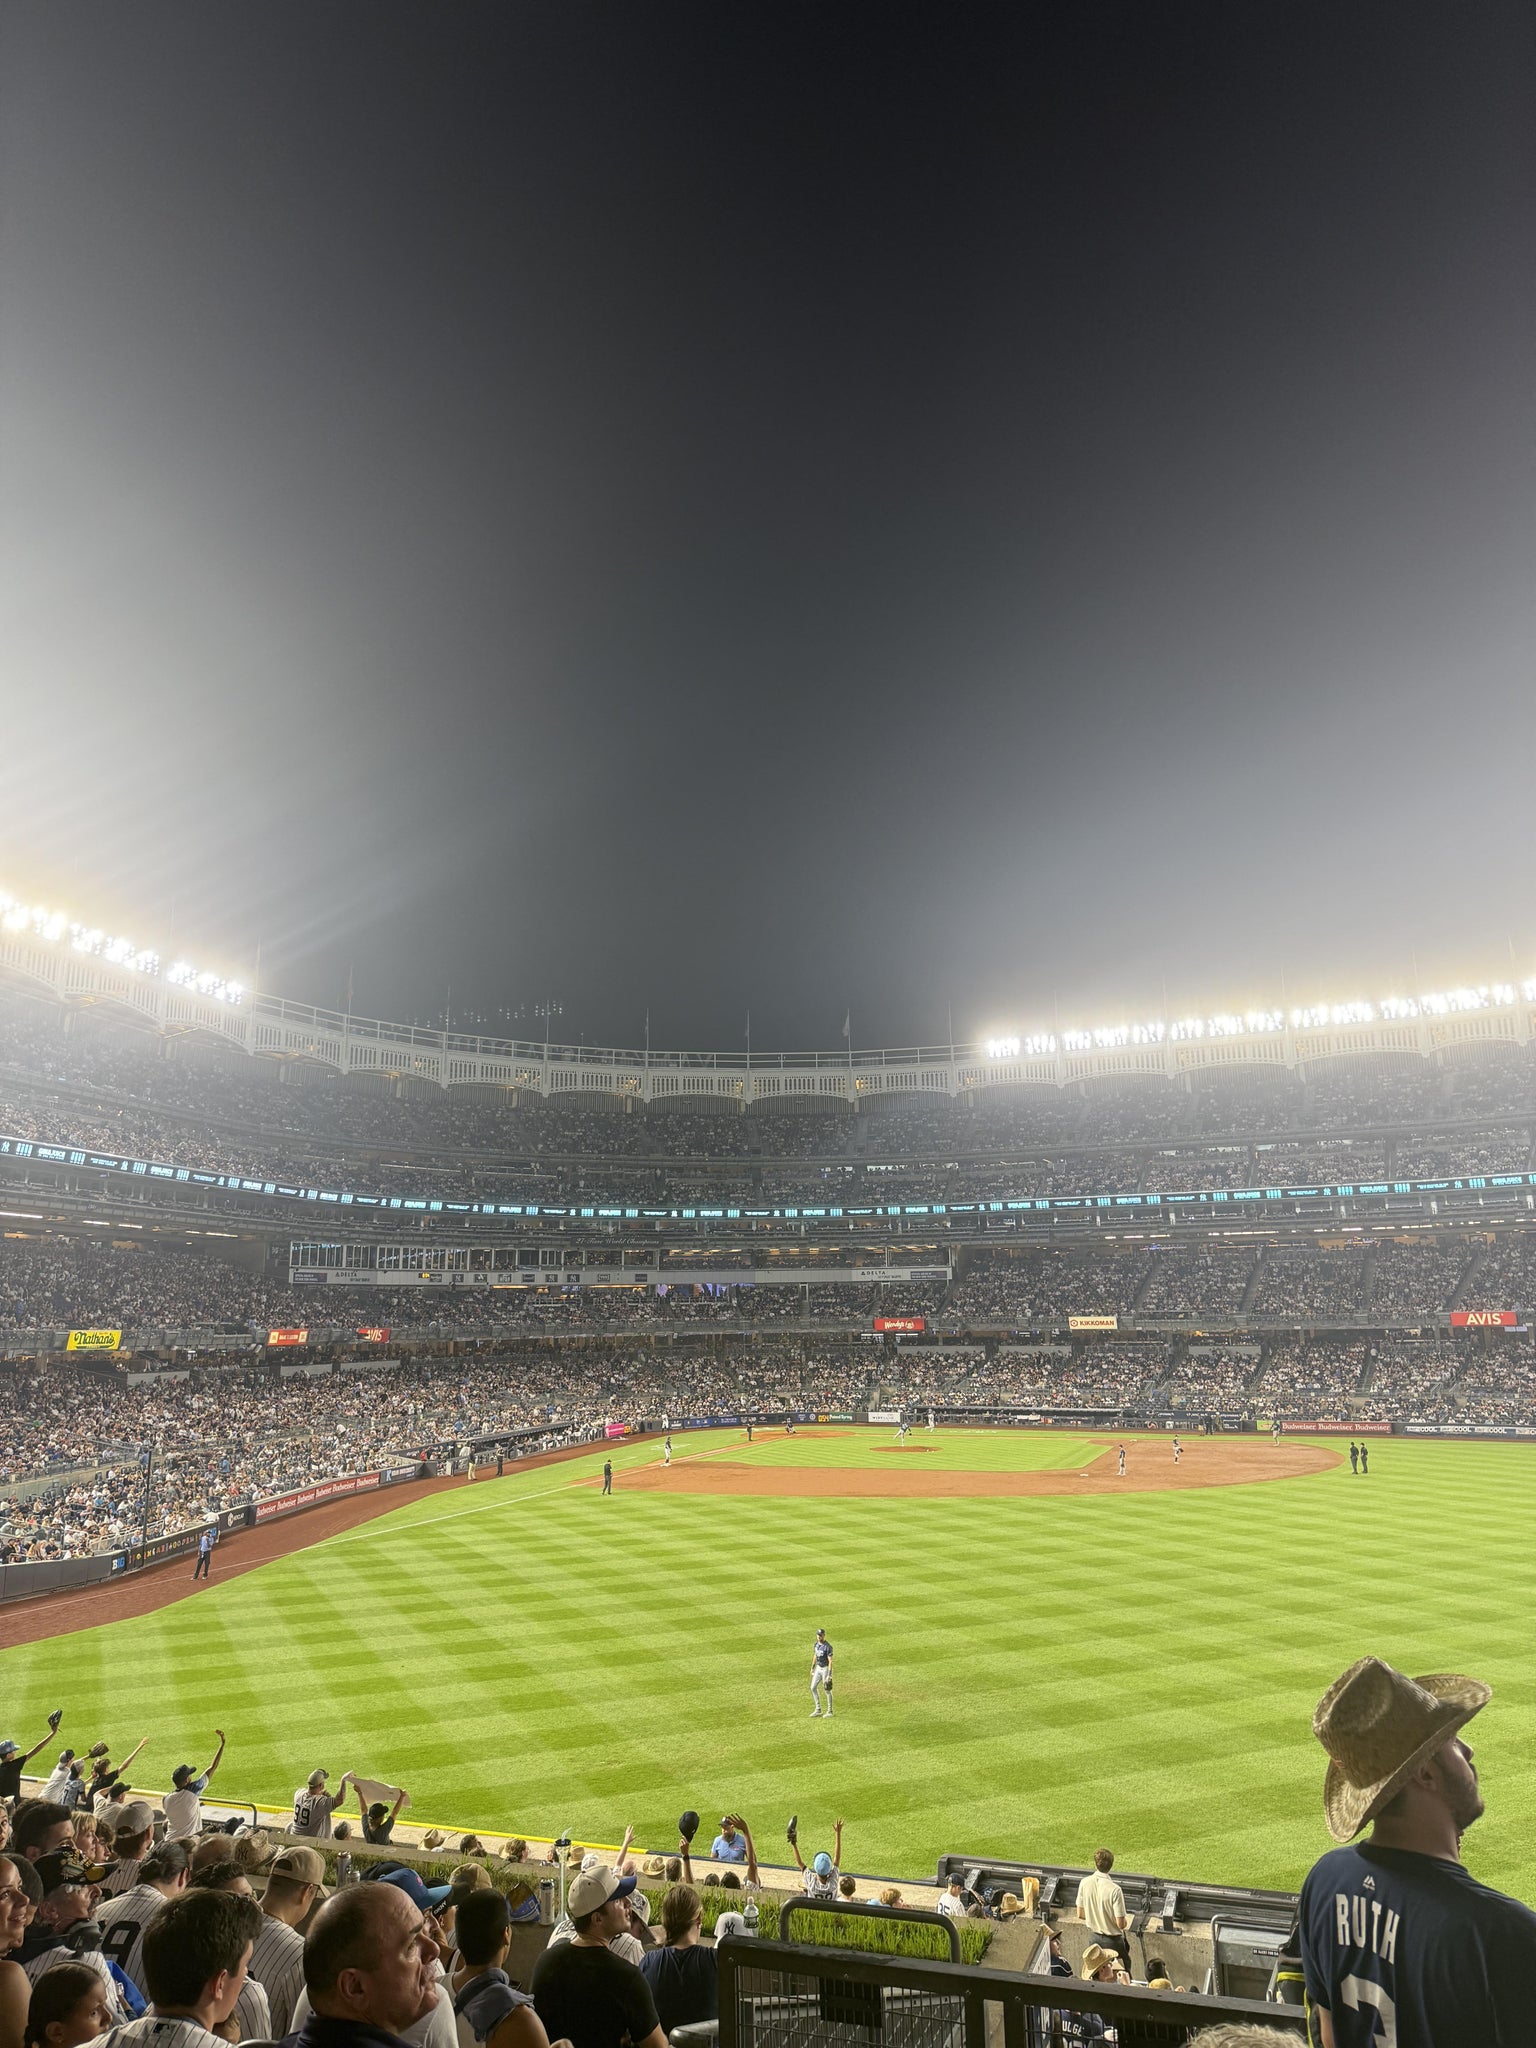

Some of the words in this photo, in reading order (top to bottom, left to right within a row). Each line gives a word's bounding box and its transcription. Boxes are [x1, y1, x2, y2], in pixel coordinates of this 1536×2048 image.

[884, 1320, 905, 1330] Wendy's
[1466, 1313, 1502, 1325] AVIS
[74, 1331, 115, 1346] Nathan's
[1282, 1422, 1316, 1431] Budweiser
[1318, 1423, 1352, 1431] Budweiser
[332, 1481, 355, 1492] Budweiser
[356, 1476, 379, 1487] Budweiser
[257, 1504, 276, 1516] Budweiser
[277, 1498, 296, 1510] Budweiser
[294, 1803, 310, 1826] 99
[1335, 1893, 1400, 1965] RUTH
